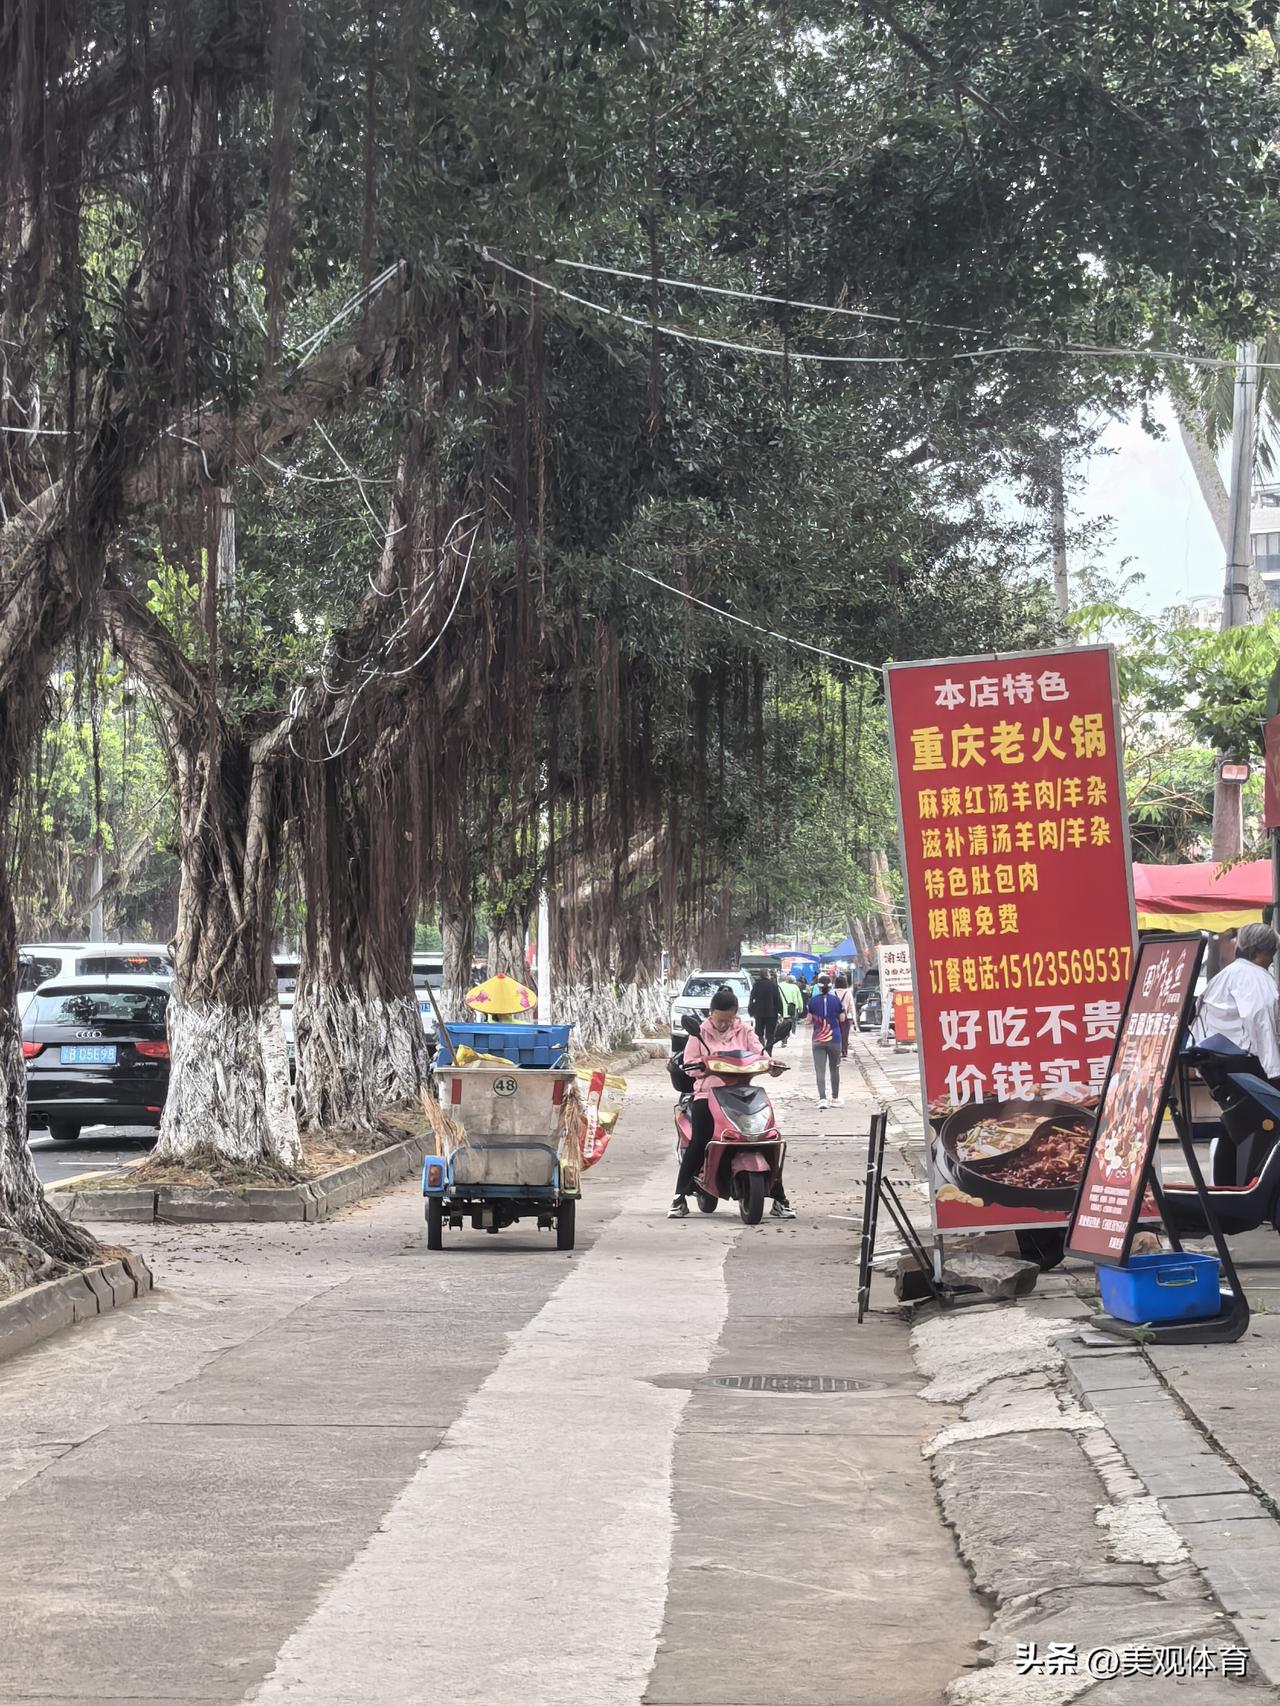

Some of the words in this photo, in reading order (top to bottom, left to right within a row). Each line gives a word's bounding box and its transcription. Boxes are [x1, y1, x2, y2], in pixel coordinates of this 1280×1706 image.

[934, 670, 1070, 710] 本店特色
[910, 713, 1107, 771] 重庆老火锅
[918, 776, 1107, 819] 麻辣红汤羊肉/羊杂
[921, 815, 1111, 859] 滋补清汤羊肉/羊杂
[924, 862, 1039, 899] 特色肚包肉
[928, 903, 1020, 939] 棋牌免费
[929, 946, 1131, 995] 订餐电话:15123569537
[939, 1000, 1121, 1052] 好吃不贵
[495, 1079, 515, 1092] 48
